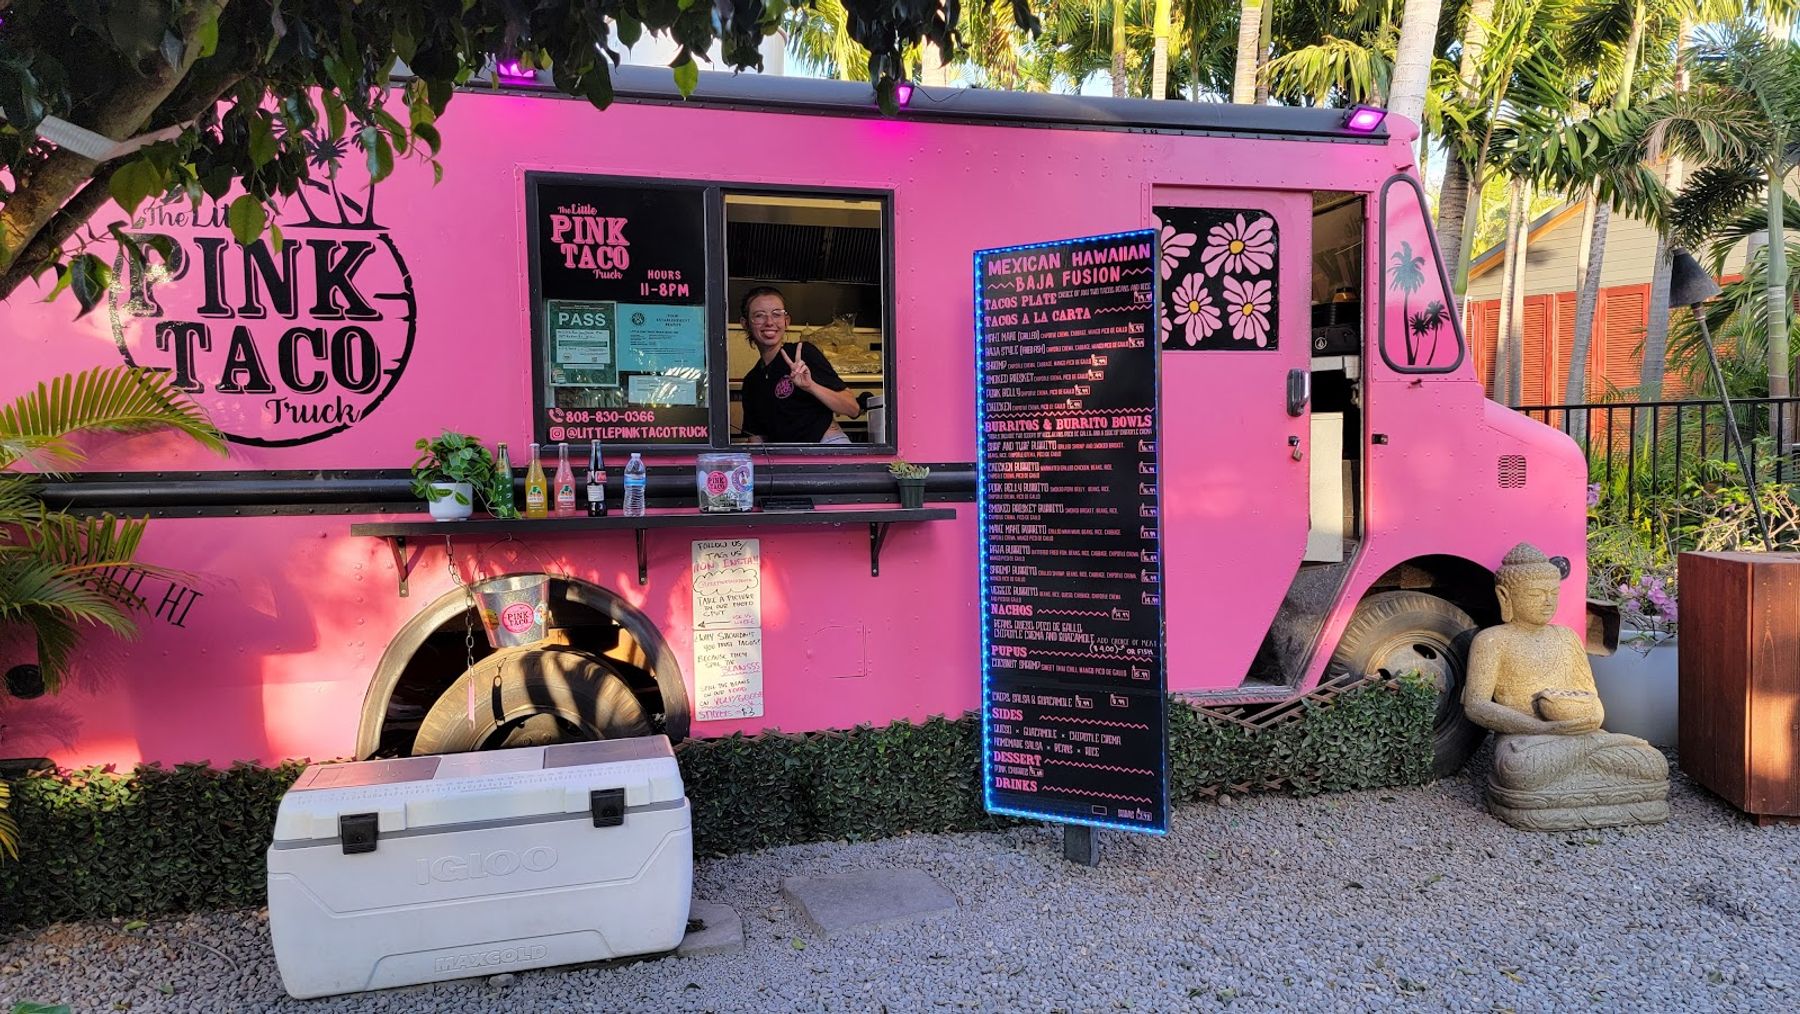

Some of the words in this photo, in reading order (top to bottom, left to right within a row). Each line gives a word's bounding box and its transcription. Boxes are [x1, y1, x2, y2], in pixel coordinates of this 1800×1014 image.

[144, 204, 190, 227] The
[558, 206, 571, 214] The
[571, 203, 597, 215] Little
[550, 214, 630, 246] PINK
[560, 243, 630, 270] TACO
[988, 252, 1061, 277] MEXICAN
[1071, 243, 1151, 268] HAWAIIAN
[125, 233, 383, 321] PINK
[592, 269, 623, 279] Truck
[648, 270, 681, 280] HOURS
[1015, 275, 1055, 293] BAJA
[1062, 266, 1121, 287] FUSION
[641, 283, 689, 297] 11-8PM
[984, 296, 1017, 310] TACOS
[1021, 292, 1056, 307] PLATE
[558, 312, 606, 327] PASS
[984, 313, 1017, 328] TACOS
[1022, 313, 1029, 324] A
[1033, 311, 1048, 323] LA
[1052, 306, 1090, 322] CARTA
[1000, 345, 1018, 355] STYLE
[155, 320, 386, 395] TACO
[1001, 387, 1020, 398] BELLY
[265, 396, 363, 426] Truck
[986, 401, 1011, 412] CHICKEN
[565, 410, 655, 423] 808-830-0366
[984, 418, 1039, 433] BURRITOS
[1042, 418, 1051, 430] &
[1056, 415, 1106, 430] BURRITO
[1112, 414, 1152, 428] BOWLS
[566, 426, 708, 439] @LITTLEPINKTACOTRUCK
[1002, 441, 1013, 451] AND
[1031, 440, 1056, 450] BURRITO
[987, 462, 1012, 472] CHICKEN
[1014, 461, 1039, 471] BURRITO
[1004, 482, 1021, 492] BELLY
[1023, 482, 1048, 492] BURRITO
[1038, 503, 1063, 513] BURRITO
[705, 551, 728, 560] TAG
[1005, 544, 1030, 554] BURRITO
[989, 565, 1010, 574] SHRIMP
[1011, 566, 1036, 575] BURRITO
[1013, 586, 1038, 596] BURRITO
[155, 582, 204, 628] HI
[990, 603, 1032, 616] NACHOS
[507, 611, 529, 620] PINK
[1052, 622, 1060, 631] DE
[994, 628, 1023, 639] CHIPOTLE
[1045, 631, 1057, 641] AND
[991, 644, 1027, 657] PUPUS
[992, 658, 1017, 668] COCONUT
[1018, 660, 1040, 670] SHRIMP
[1012, 693, 1029, 703] SALSA
[1031, 695, 1035, 703] &
[1037, 695, 1072, 707] GUACAMOLE
[992, 707, 1023, 720] SIDES
[1023, 726, 1056, 738] GUACAMOLE
[1069, 730, 1098, 742] CHIPOTLE
[1024, 740, 1042, 750] SALSA
[993, 750, 1042, 766] DESSERT
[995, 777, 1037, 791] DRINKS
[416, 846, 559, 885] IGLOO
[434, 945, 548, 972] MAXCOLD
